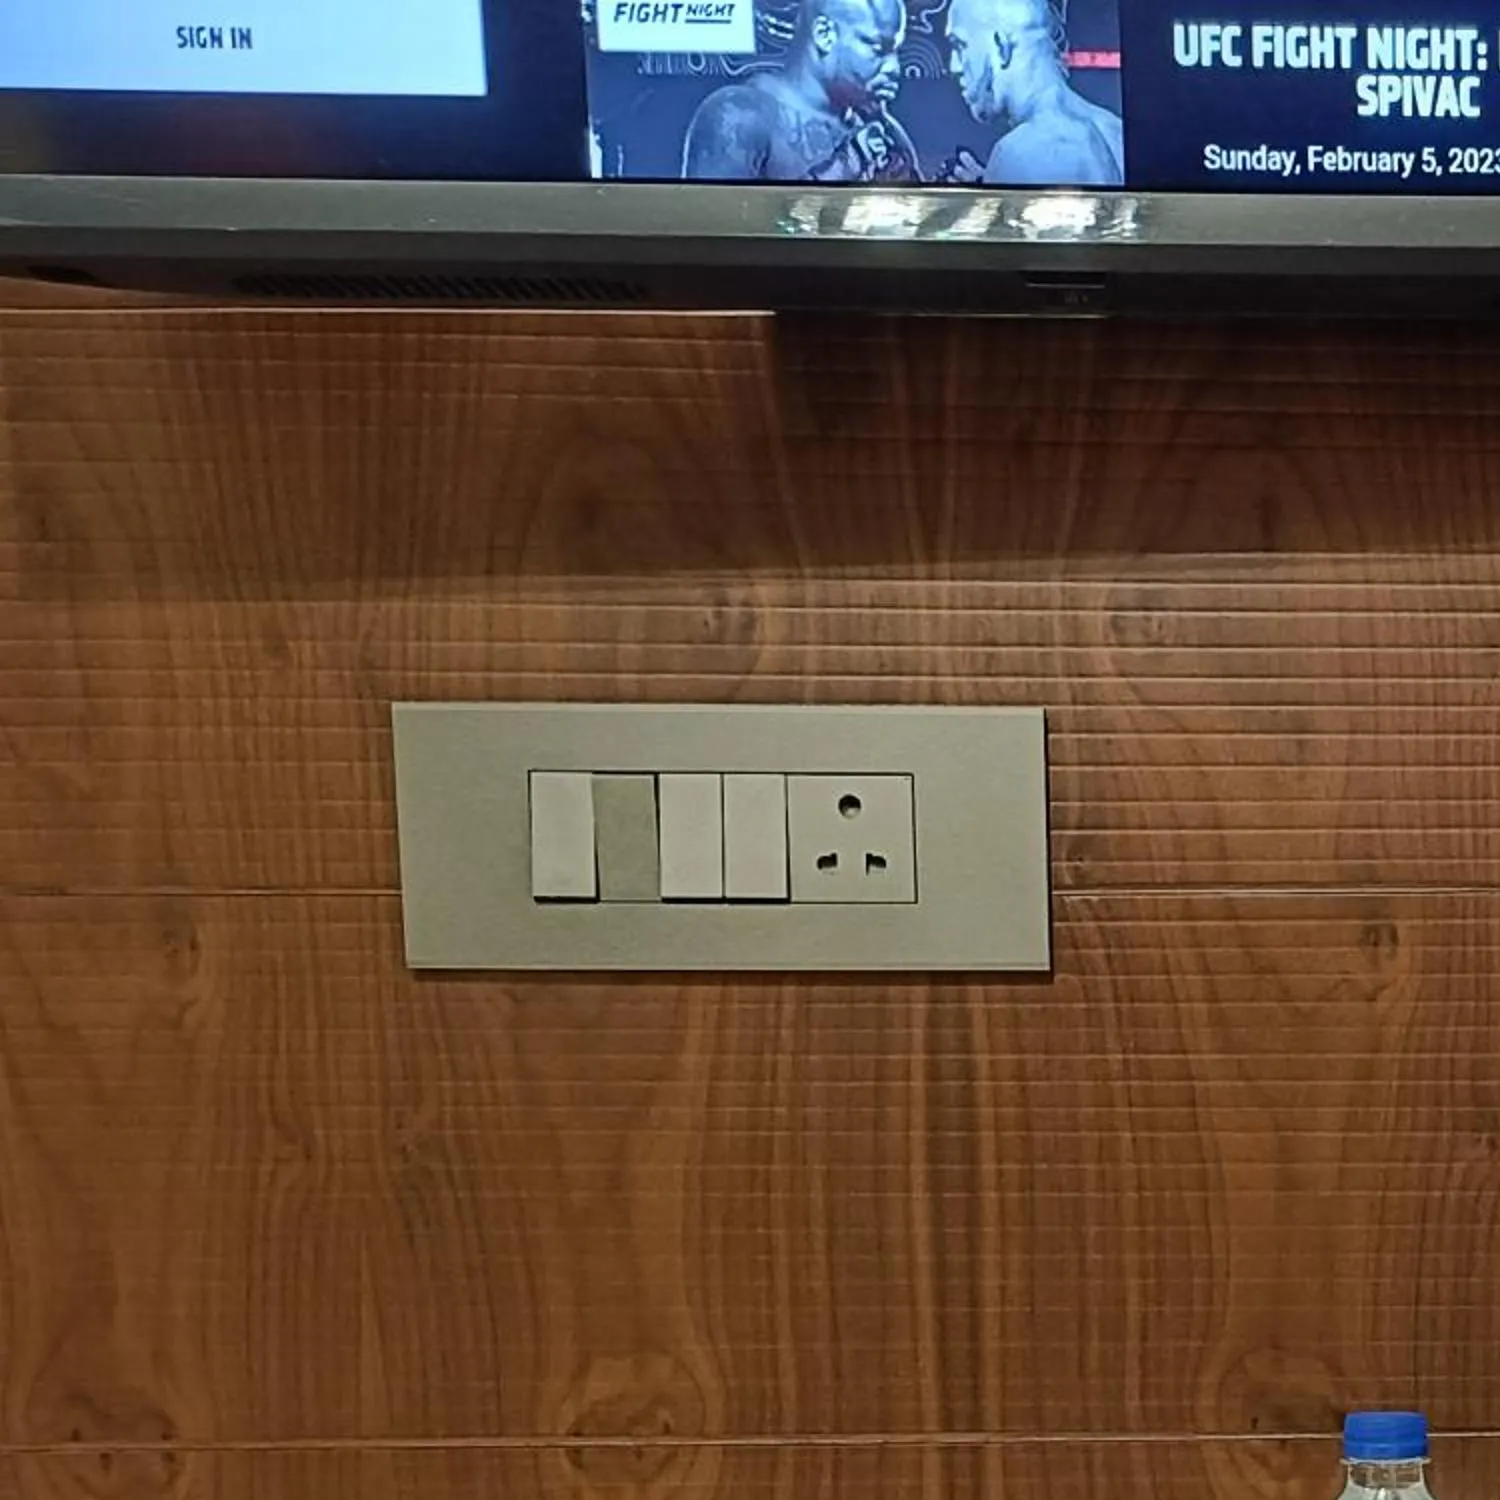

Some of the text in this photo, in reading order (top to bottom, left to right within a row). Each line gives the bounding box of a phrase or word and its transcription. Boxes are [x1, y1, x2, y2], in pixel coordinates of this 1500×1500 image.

[614, 3, 735, 23] FIGHT NIGHT
[176, 25, 253, 49] SIGN IN
[1173, 23, 1242, 67] UFC
[1252, 25, 1357, 69] FIGHT
[1366, 26, 1488, 71] NIGHT:
[1356, 74, 1481, 117] SPIVAC
[1204, 144, 1300, 176] Sunday,
[1307, 145, 1415, 179] February
[1421, 147, 1443, 176] 5,
